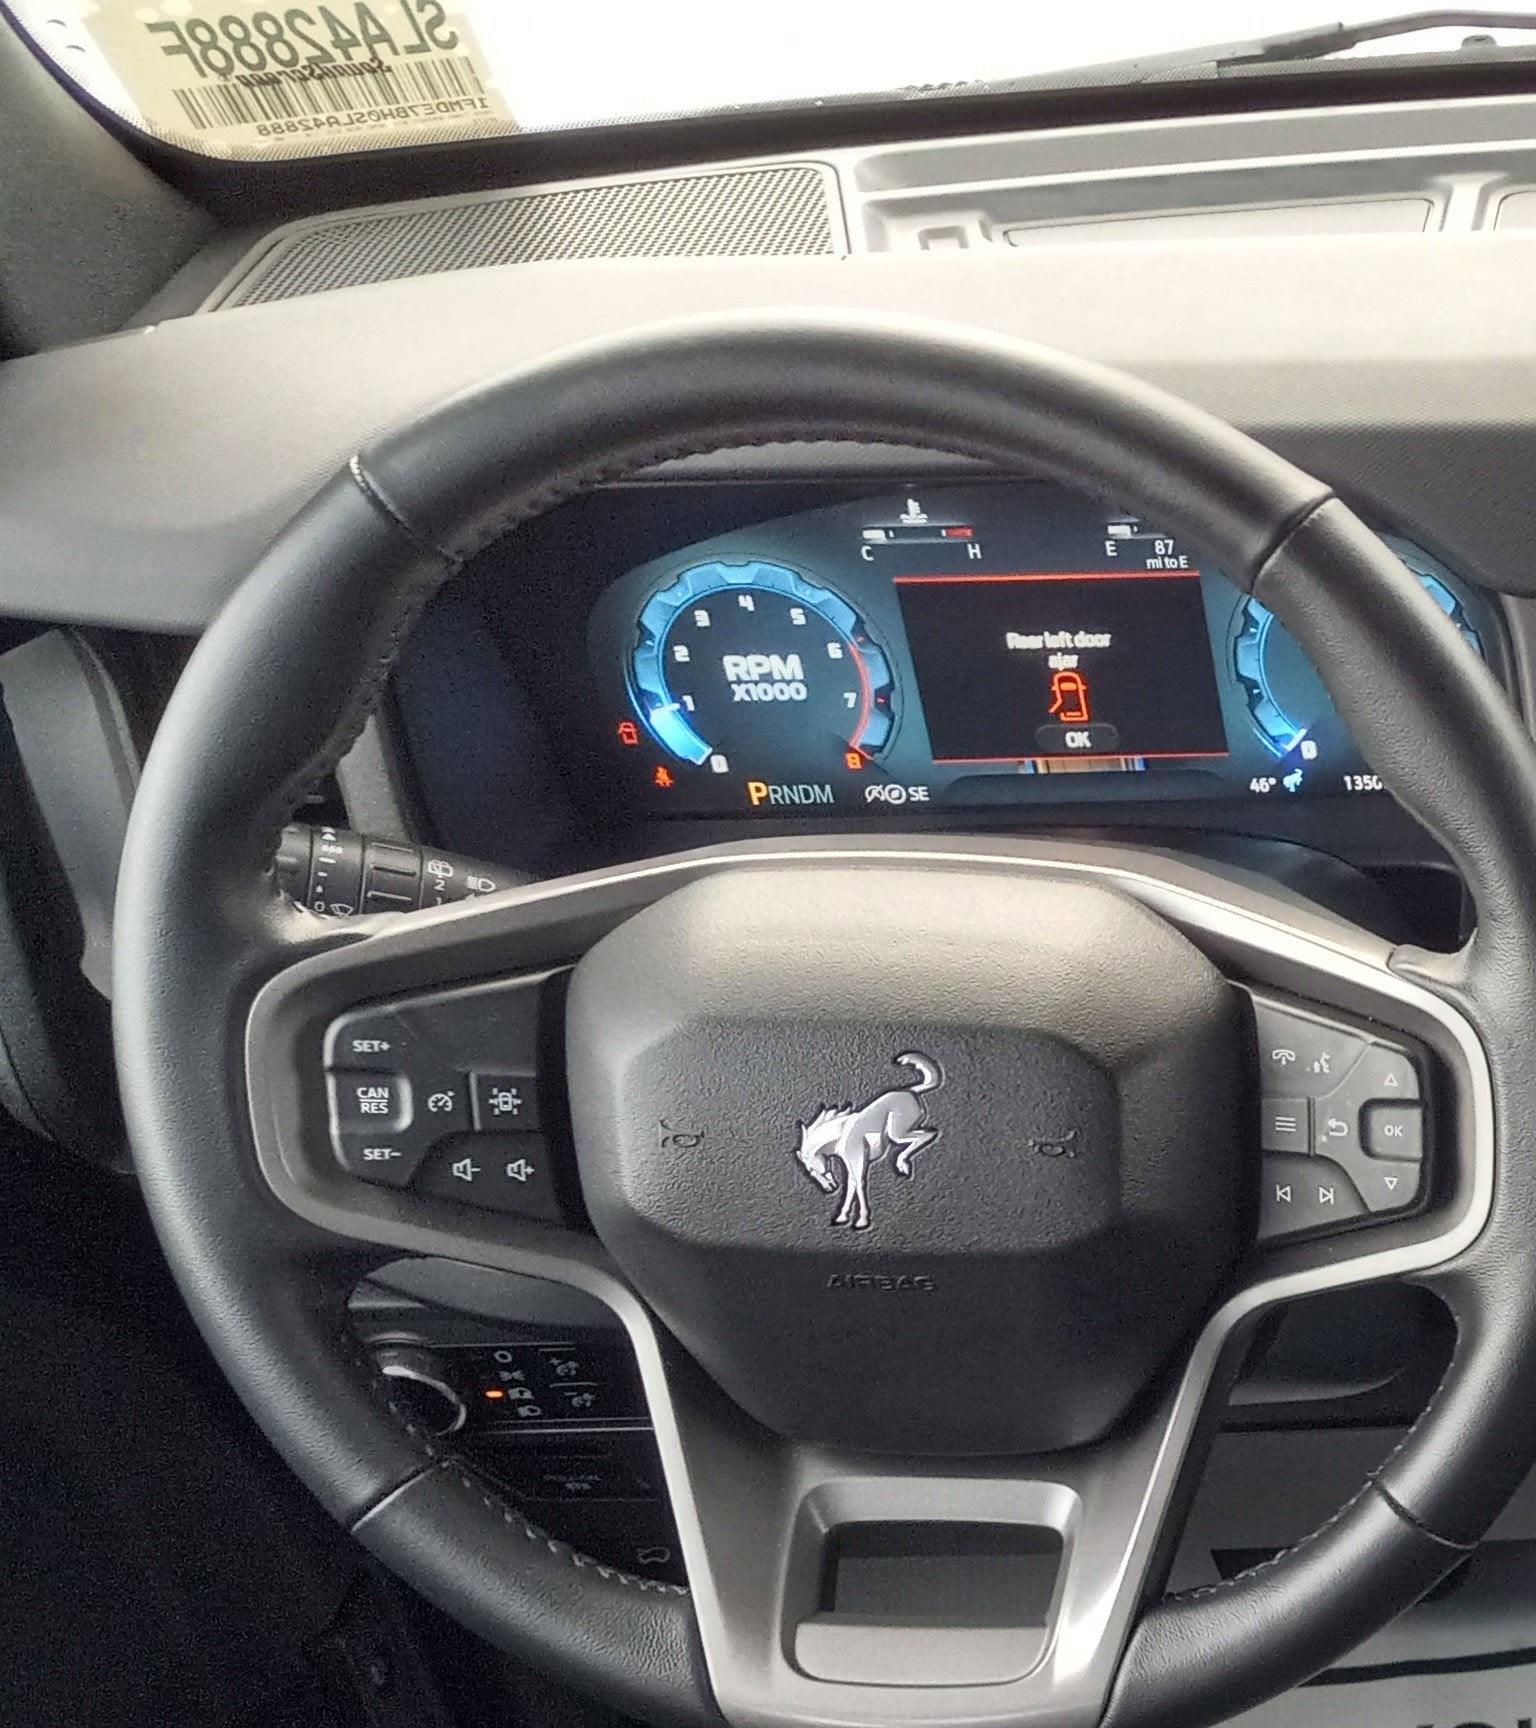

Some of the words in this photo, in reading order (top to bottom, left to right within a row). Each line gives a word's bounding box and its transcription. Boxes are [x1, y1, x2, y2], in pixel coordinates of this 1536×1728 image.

[860, 545, 874, 561] C
[967, 543, 982, 560] H
[1105, 541, 1118, 557] E
[1154, 539, 1175, 556] 87
[1164, 557, 1178, 569] to
[1179, 555, 1189, 569] E
[738, 594, 755, 611] 4
[694, 609, 711, 627] 3
[790, 608, 806, 625] 5
[1006, 632, 1043, 650] Rear
[1044, 631, 1073, 649] left
[1074, 631, 1112, 649] door
[673, 645, 691, 662] 2
[827, 642, 843, 659] 6
[723, 653, 804, 681] RPM
[1048, 653, 1078, 671] ajar
[683, 695, 695, 712] 1
[843, 692, 857, 708] 7
[1064, 731, 1092, 748] OK
[1300, 740, 1317, 760] 0
[710, 754, 729, 773] 0
[845, 752, 862, 770] 8
[908, 785, 930, 802] SE
[352, 1039, 391, 1052] SET+
[356, 1086, 389, 1099] CAN
[360, 1102, 389, 1114] RES
[1384, 1124, 1404, 1137] OK
